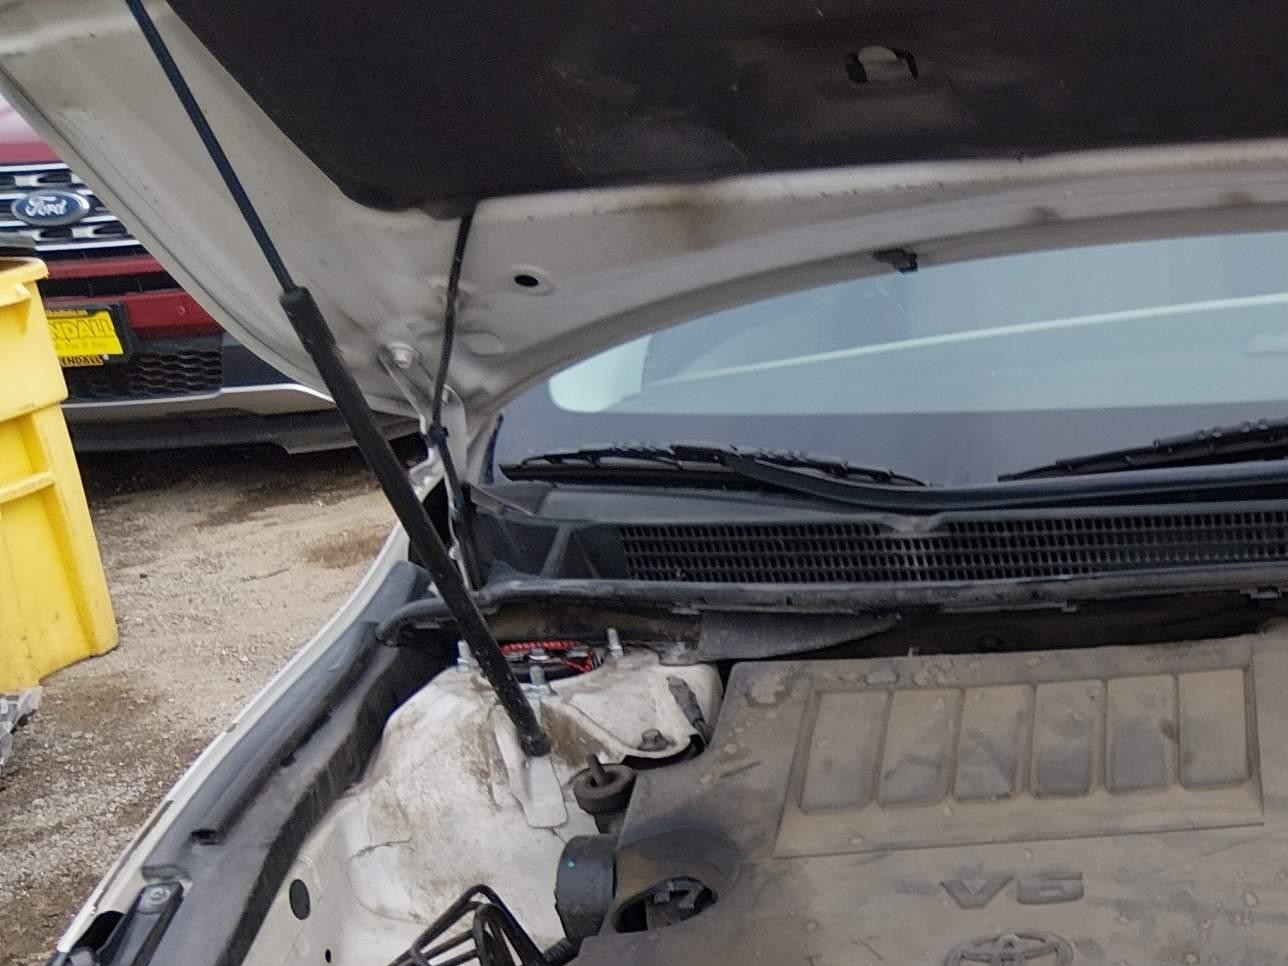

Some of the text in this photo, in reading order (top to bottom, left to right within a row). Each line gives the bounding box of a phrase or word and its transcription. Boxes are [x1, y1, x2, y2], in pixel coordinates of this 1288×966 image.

[25, 196, 68, 217] Ford
[48, 318, 116, 342] NDALL
[60, 355, 104, 367] ENDALL
[938, 872, 1085, 910] V6
